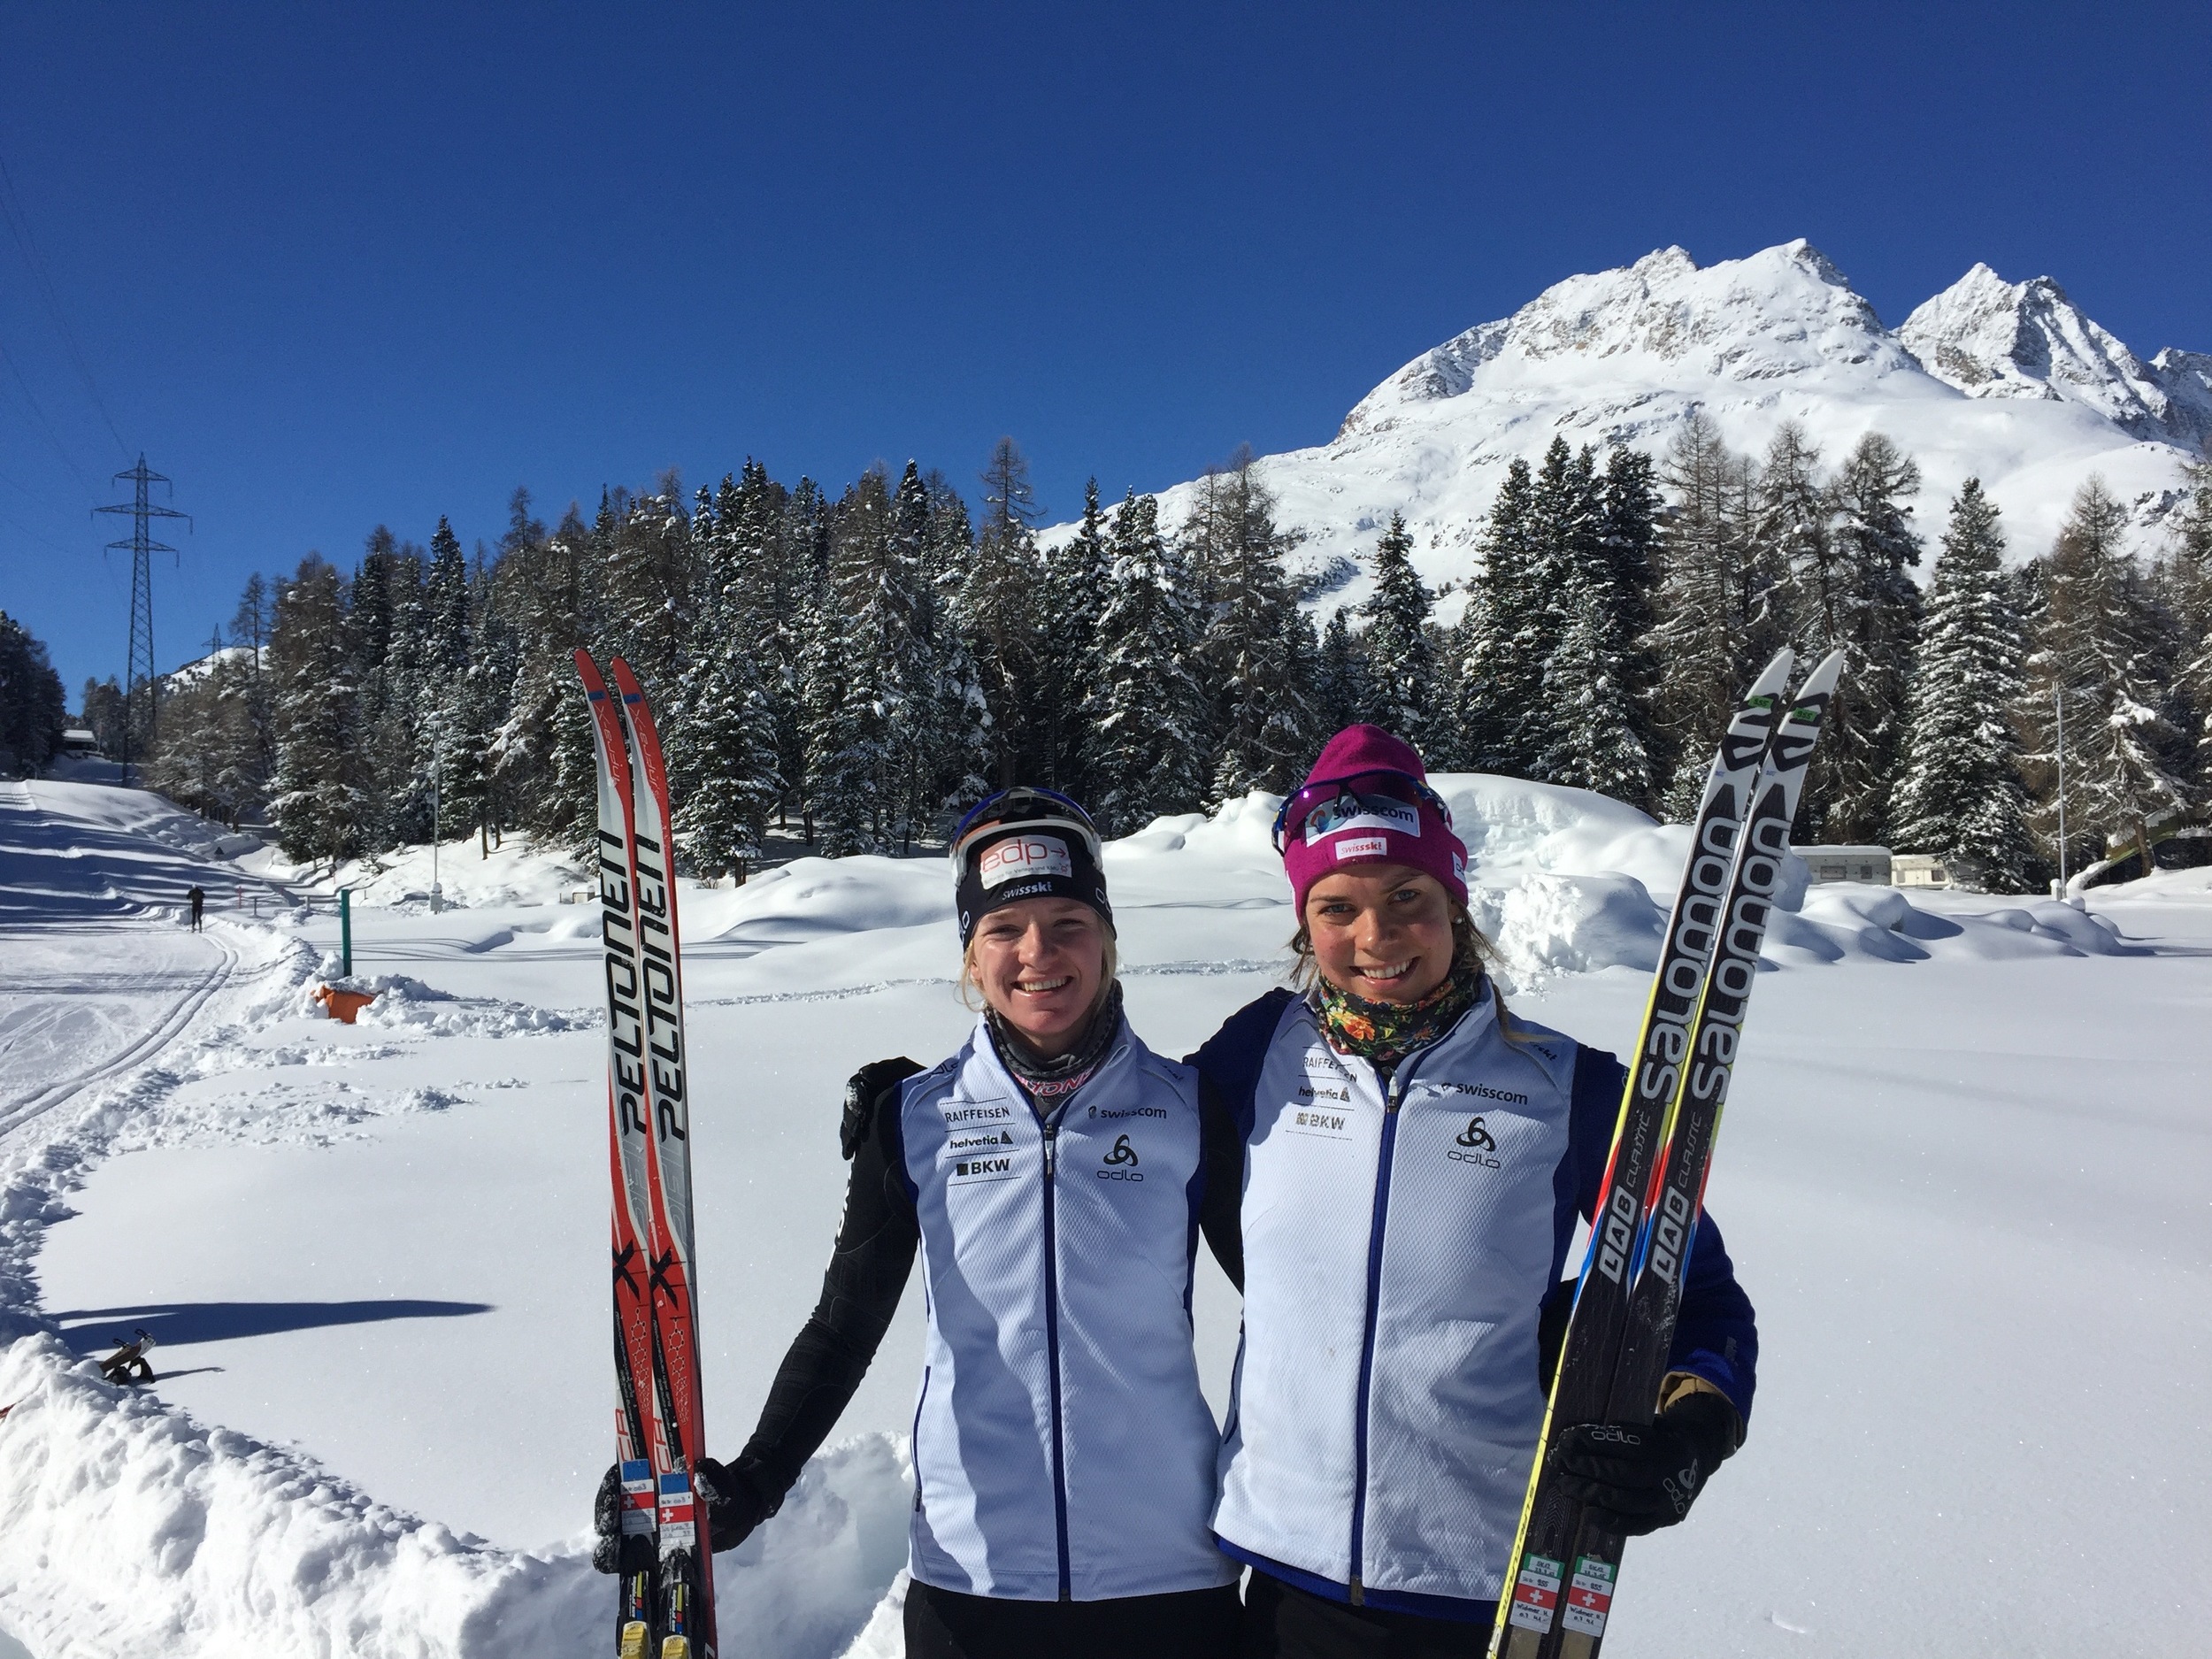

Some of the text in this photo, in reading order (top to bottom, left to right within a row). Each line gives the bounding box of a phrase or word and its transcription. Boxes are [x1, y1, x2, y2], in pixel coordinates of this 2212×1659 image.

[982, 839, 1048, 873] edp
[1298, 1086, 1339, 1101] helvetia
[1455, 1081, 1528, 1106] swisscom
[944, 1106, 1010, 1124] RAIFFEISEN
[1100, 1106, 1168, 1119] swisscom
[1310, 1113, 1346, 1131] BKW
[949, 1135, 998, 1149] helvetia
[971, 1158, 1010, 1175] BKW
[1447, 1150, 1501, 1170] odlo
[1096, 1170, 1144, 1182] odlo
[1591, 1429, 1641, 1446] odlo
[1570, 1606, 1594, 1617] Widmer
